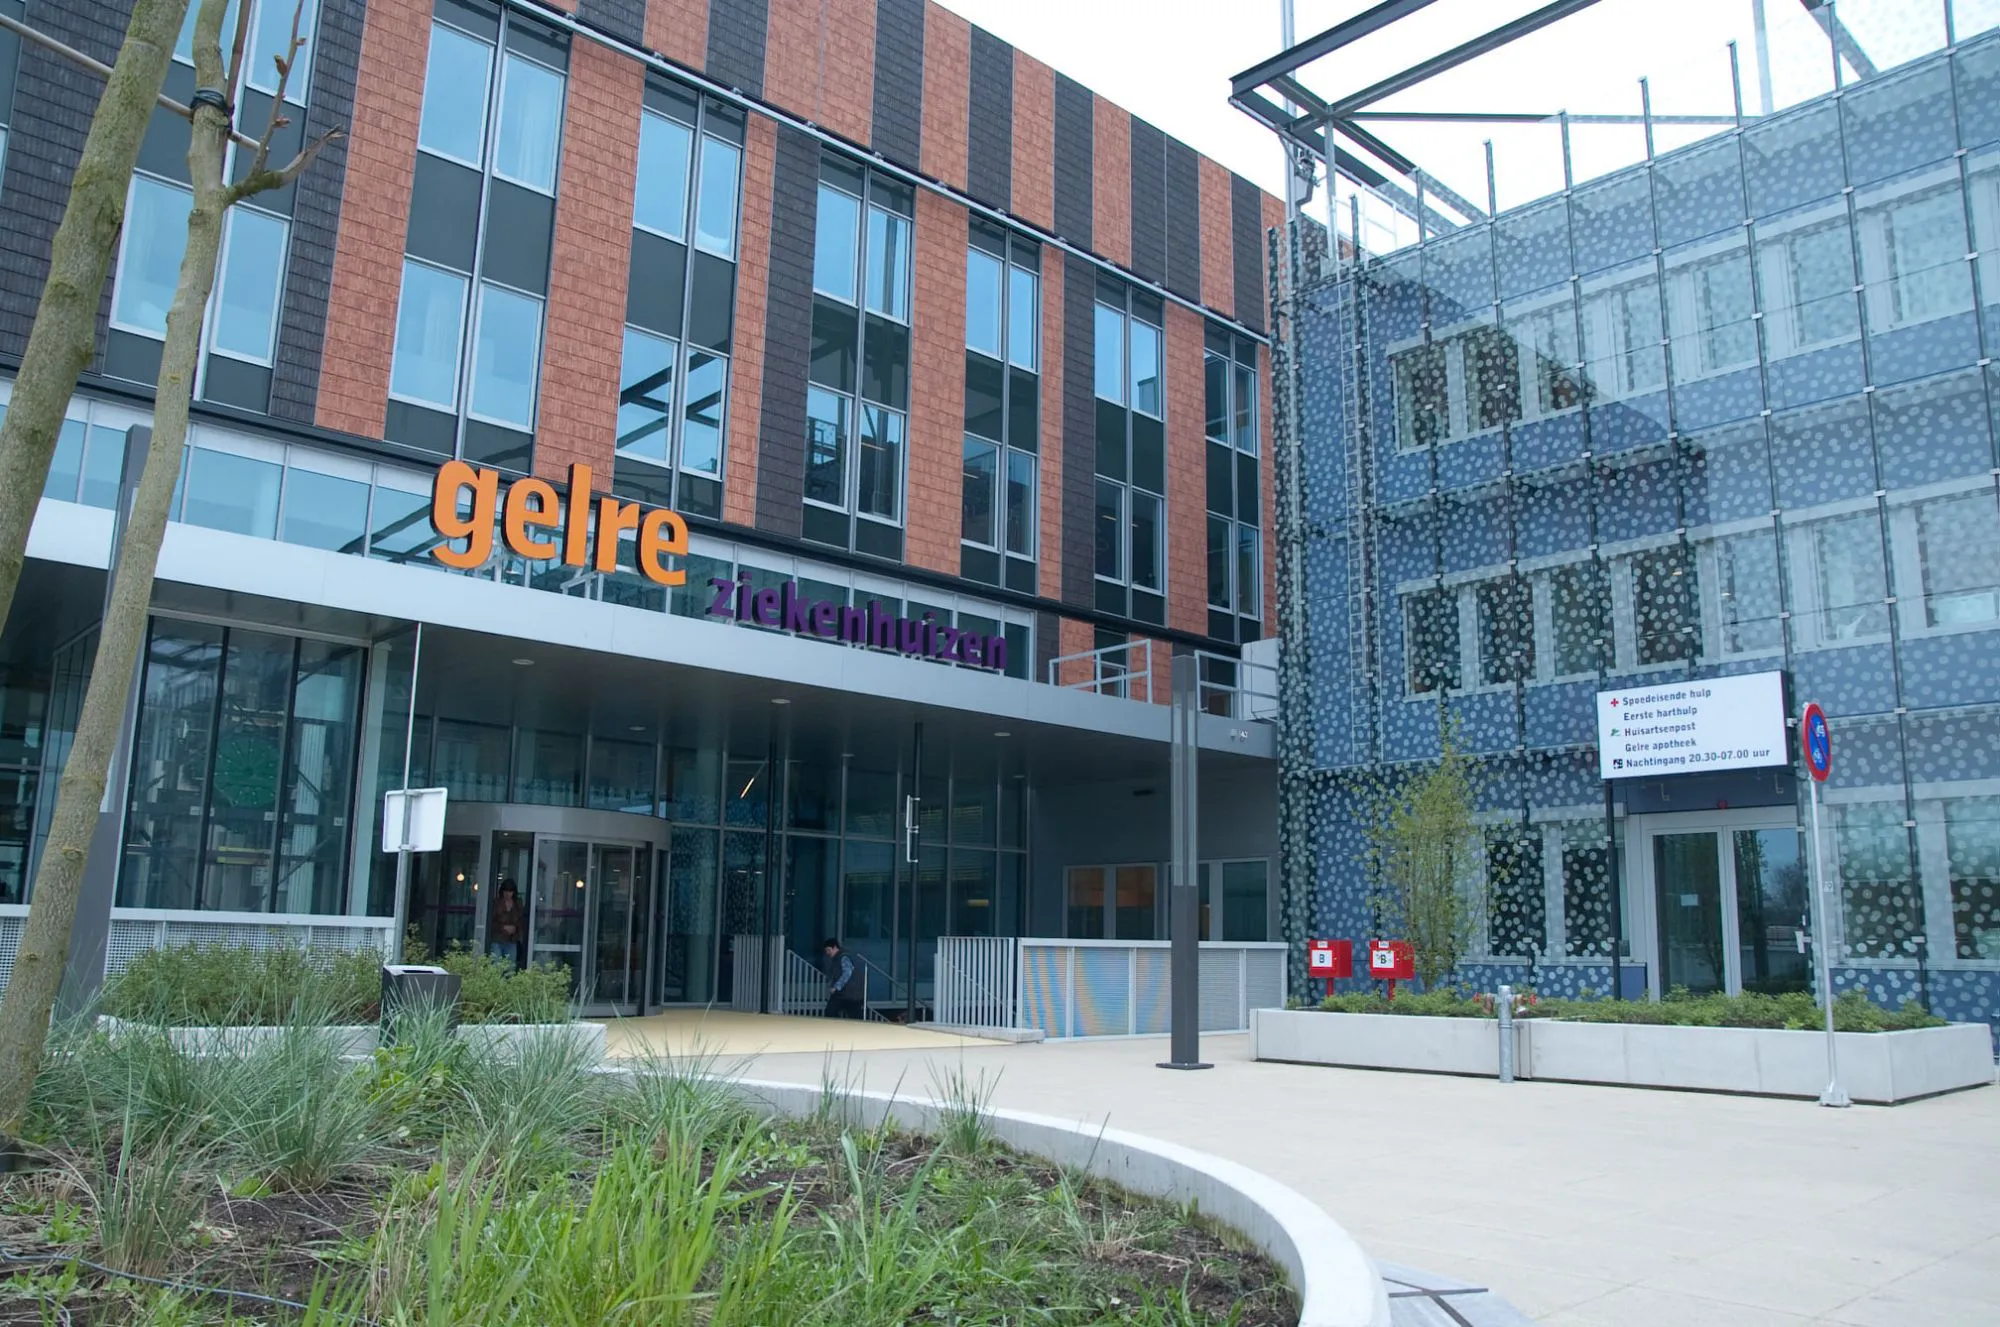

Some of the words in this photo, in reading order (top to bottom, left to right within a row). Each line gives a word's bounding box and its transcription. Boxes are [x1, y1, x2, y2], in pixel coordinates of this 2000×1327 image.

[430, 459, 689, 587] gelre
[705, 571, 1008, 671] ziekenhuizen
[1622, 691, 1687, 706] Spoedeisende
[1690, 688, 1711, 698] hulp
[1623, 710, 1654, 721] Eerste
[1656, 706, 1698, 717] harthulp
[1624, 722, 1696, 736] Huisartsenpost
[1625, 743, 1650, 752] Gelre
[1652, 738, 1697, 751] apotheek
[1626, 756, 1686, 768] Nachtingang
[1689, 749, 1749, 763] 20.30-07.00
[1752, 749, 1770, 758] uur
[1319, 953, 1325, 963] B
[1380, 954, 1387, 964] B
